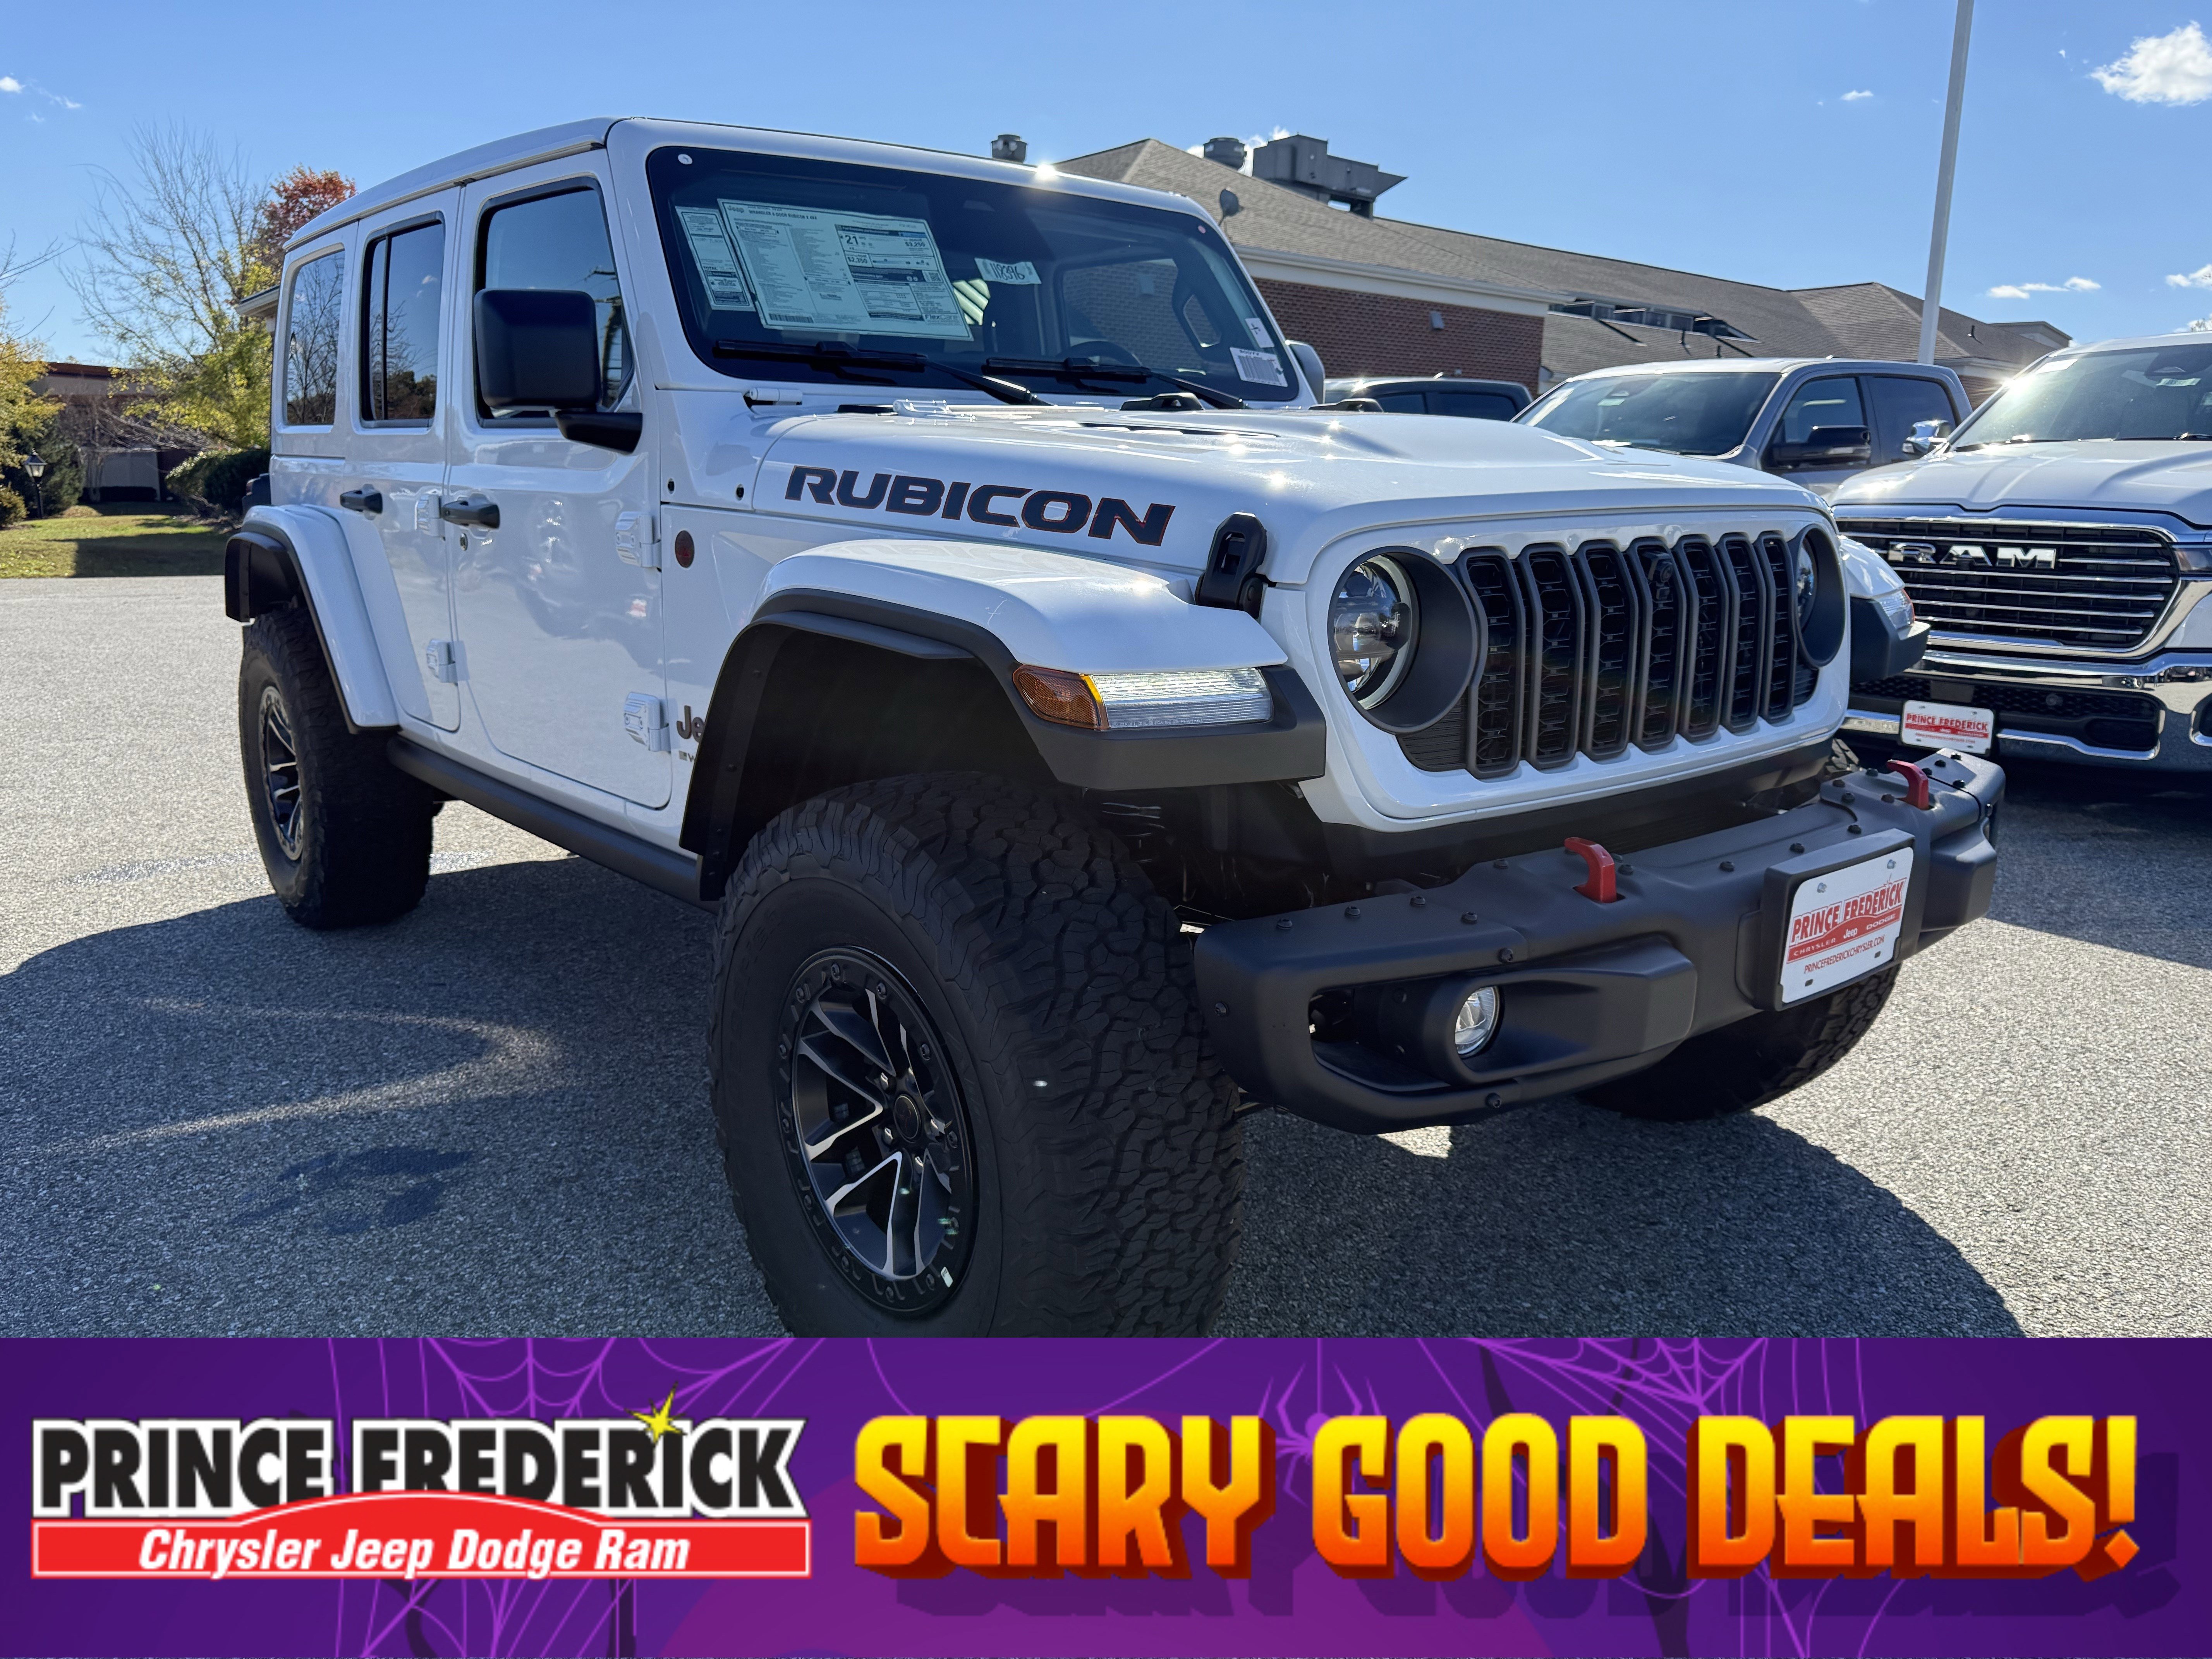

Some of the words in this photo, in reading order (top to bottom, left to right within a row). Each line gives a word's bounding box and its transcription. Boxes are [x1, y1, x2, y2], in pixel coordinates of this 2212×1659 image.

[845, 235, 859, 245] 21
[785, 465, 1176, 546] RUBICON
[1888, 542, 2056, 569] RAM
[677, 705, 706, 743] Je
[1906, 714, 1936, 725] PRINCE
[1939, 718, 1988, 731] FREDERICK
[1791, 904, 1841, 943] PRINCE
[1843, 881, 1904, 922] FREDERICK
[1793, 938, 1836, 957] CHRYSLER
[1843, 927, 1858, 939] Jeep
[1866, 914, 1895, 930] DODGE
[1804, 934, 1885, 974] PRINCEFREDERICKCHRYSLER.COM
